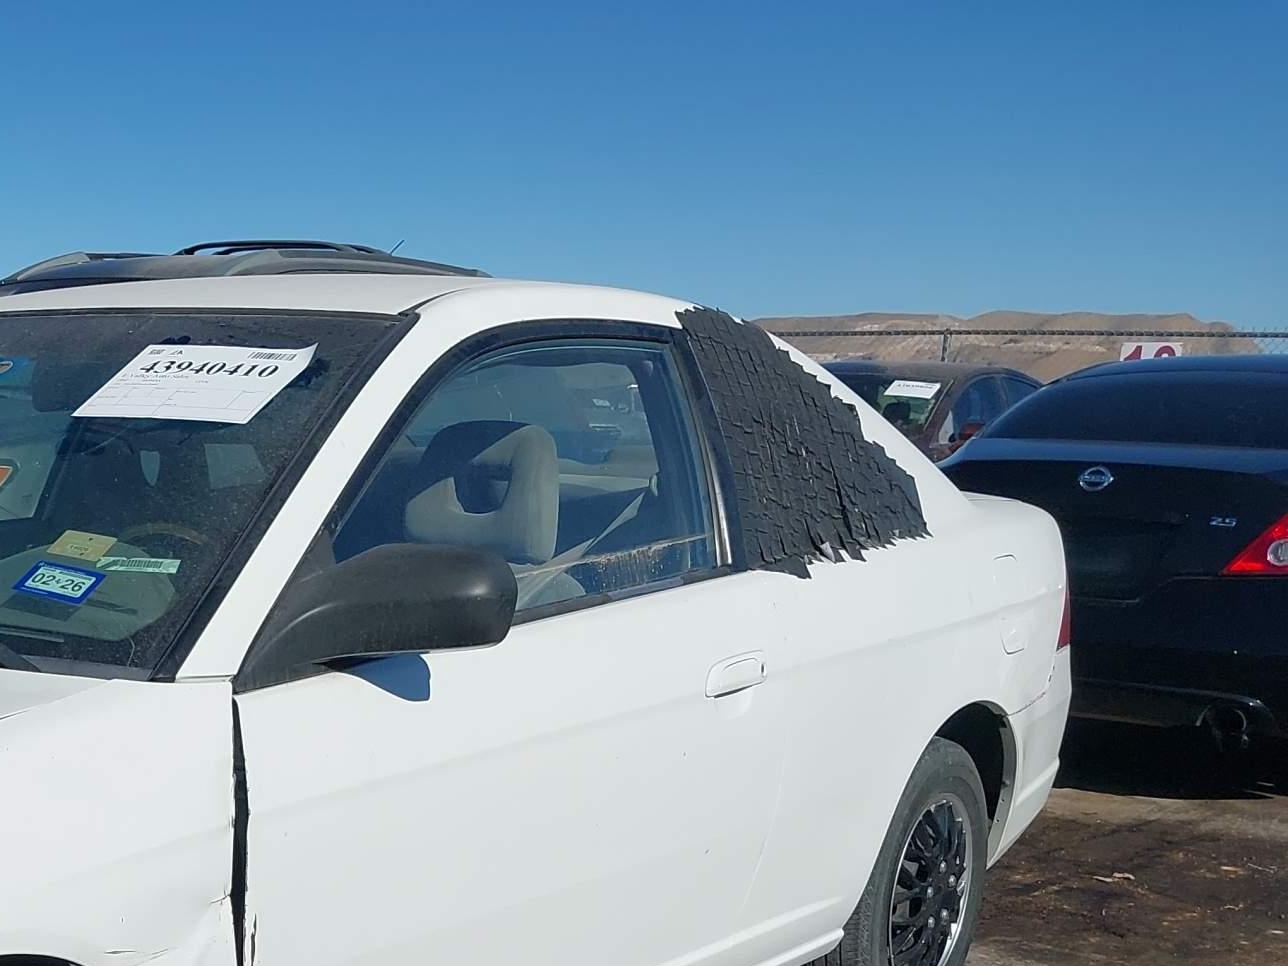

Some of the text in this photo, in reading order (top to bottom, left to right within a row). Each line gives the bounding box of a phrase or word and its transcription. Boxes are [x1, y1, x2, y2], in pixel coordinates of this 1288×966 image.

[139, 360, 280, 378] 43940410
[31, 573, 56, 585] 02
[59, 578, 86, 592] 26
